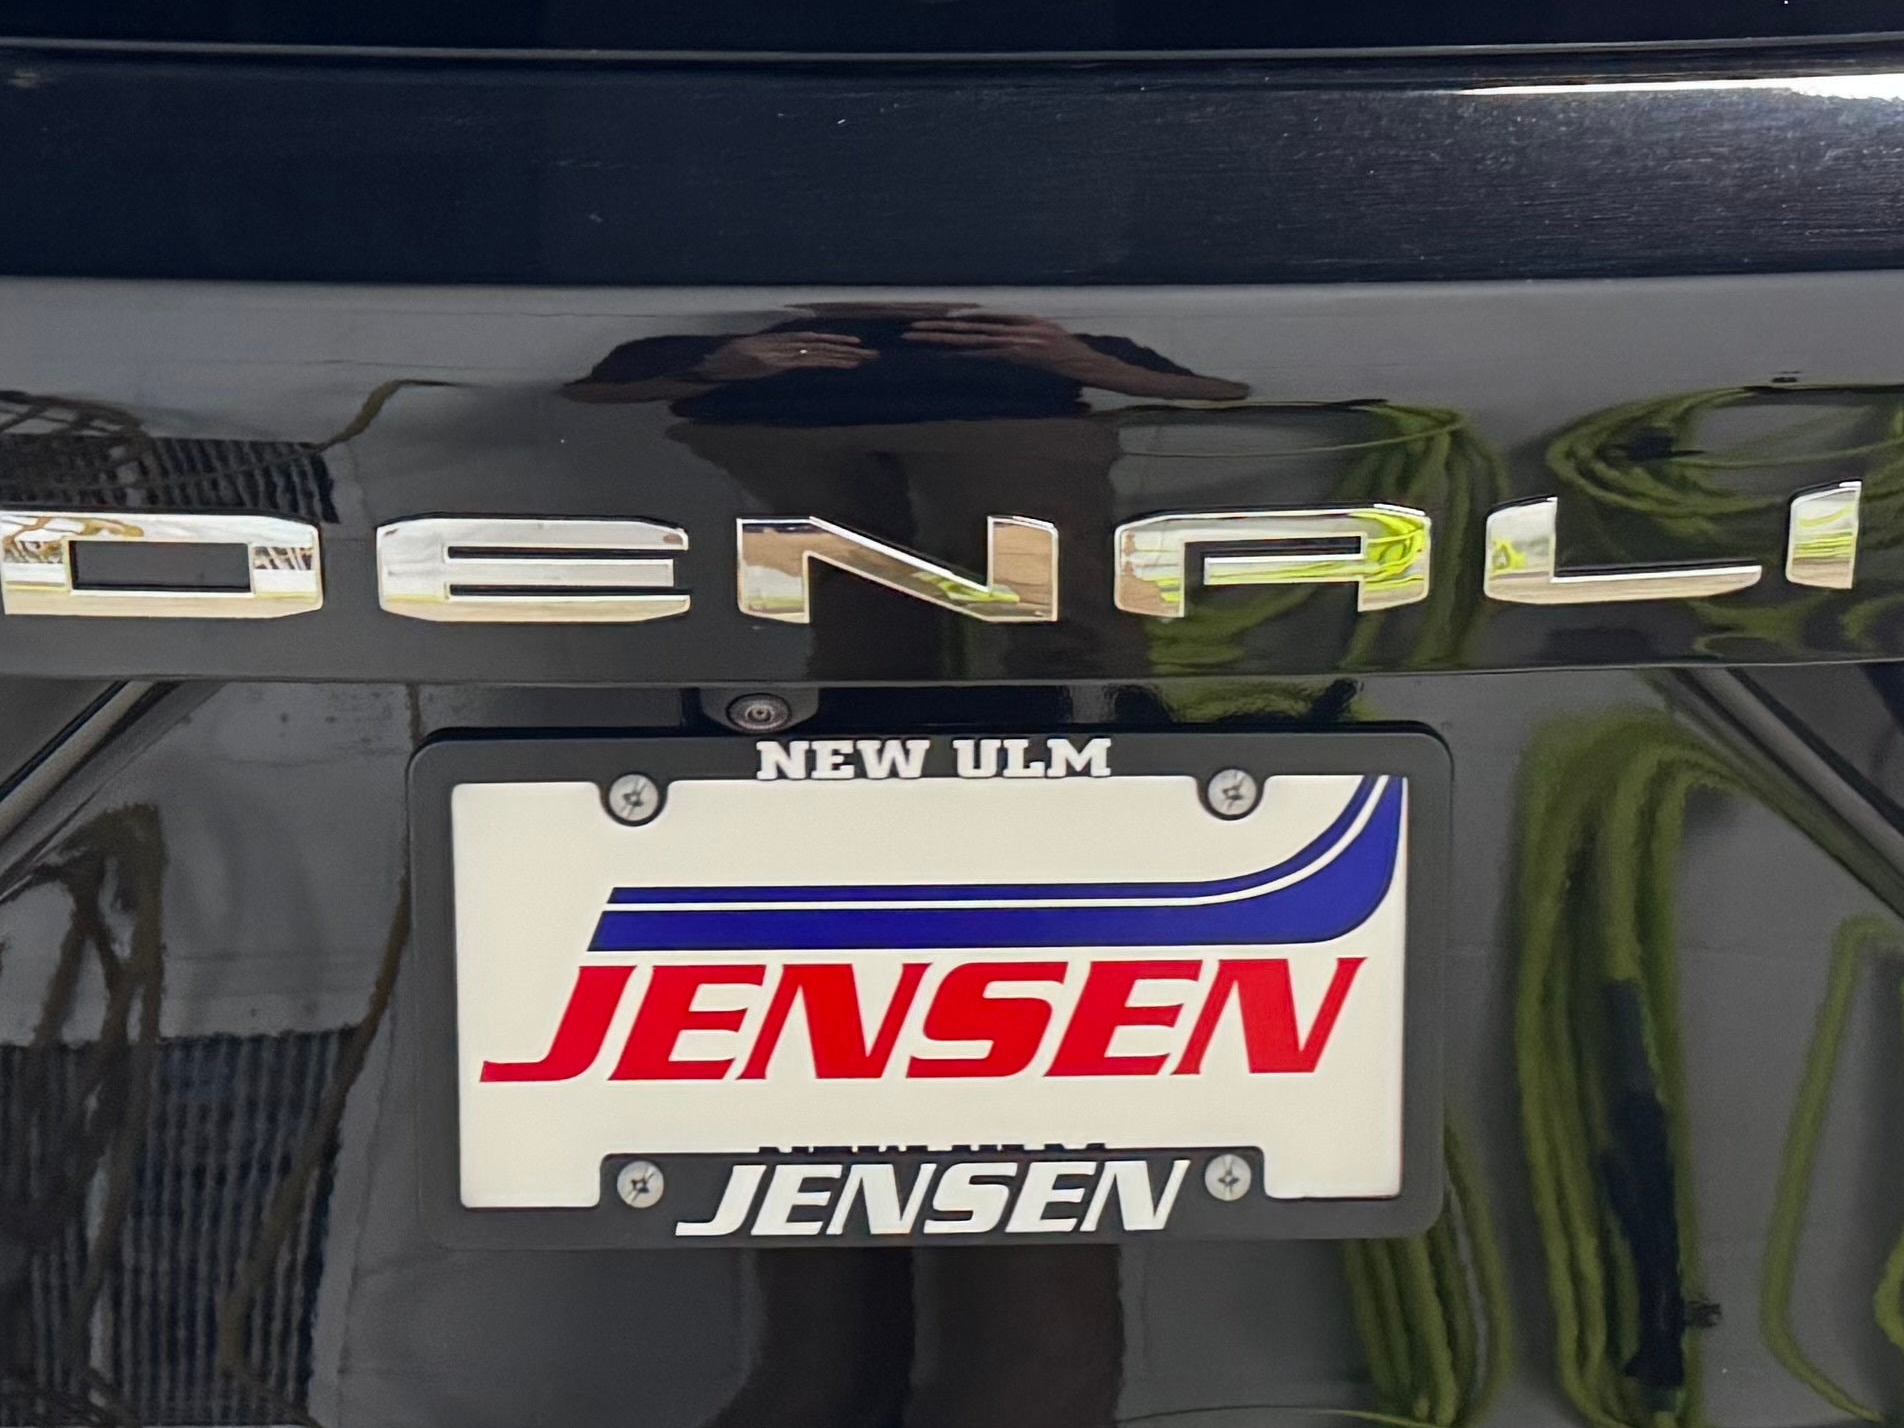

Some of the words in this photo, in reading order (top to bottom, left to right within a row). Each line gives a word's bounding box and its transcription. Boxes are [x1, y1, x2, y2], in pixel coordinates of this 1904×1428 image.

[756, 740, 930, 780] NEW
[953, 738, 1112, 779] ULM
[480, 956, 1367, 1083] JENSEN
[675, 1159, 1191, 1236] JENSEN
